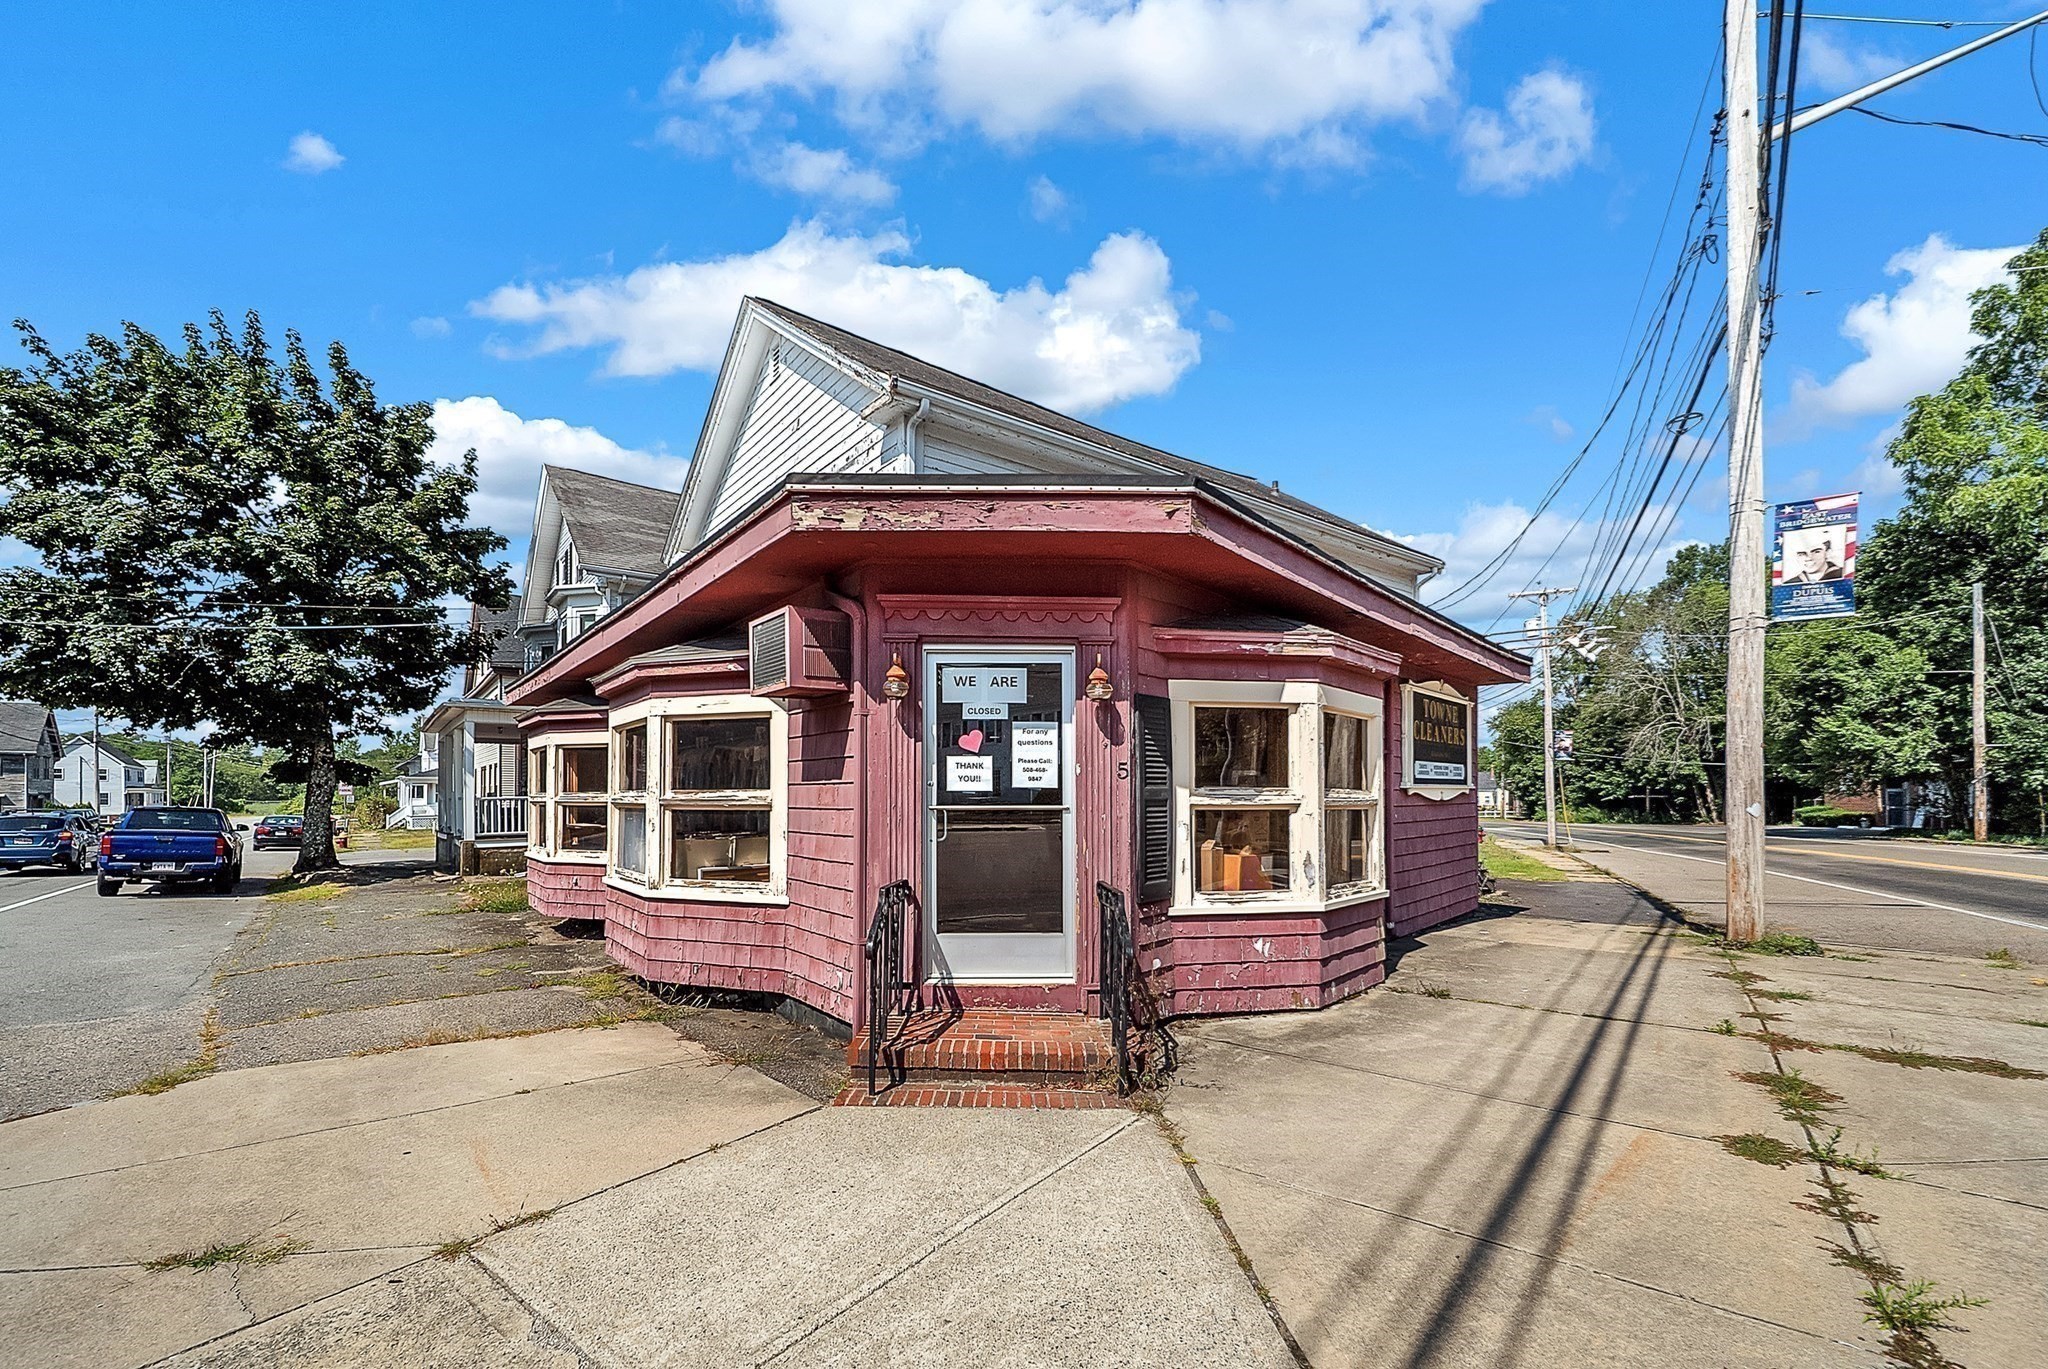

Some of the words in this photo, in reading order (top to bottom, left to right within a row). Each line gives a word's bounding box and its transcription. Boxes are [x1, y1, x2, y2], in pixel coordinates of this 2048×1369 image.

[1802, 510, 1828, 520] EAST
[1779, 514, 1852, 528] BRIDGEWATER
[1793, 586, 1835, 597] DUPUIS
[953, 675, 977, 687] WE
[989, 676, 1018, 687] ARE
[967, 707, 1002, 715] CLOSED
[1422, 698, 1458, 723] TOWNE
[1413, 719, 1466, 746] CLEANERS
[1017, 739, 1053, 747] questions
[955, 762, 984, 770] THANK
[1116, 761, 1129, 780] 5
[957, 775, 982, 783] YOU!!
